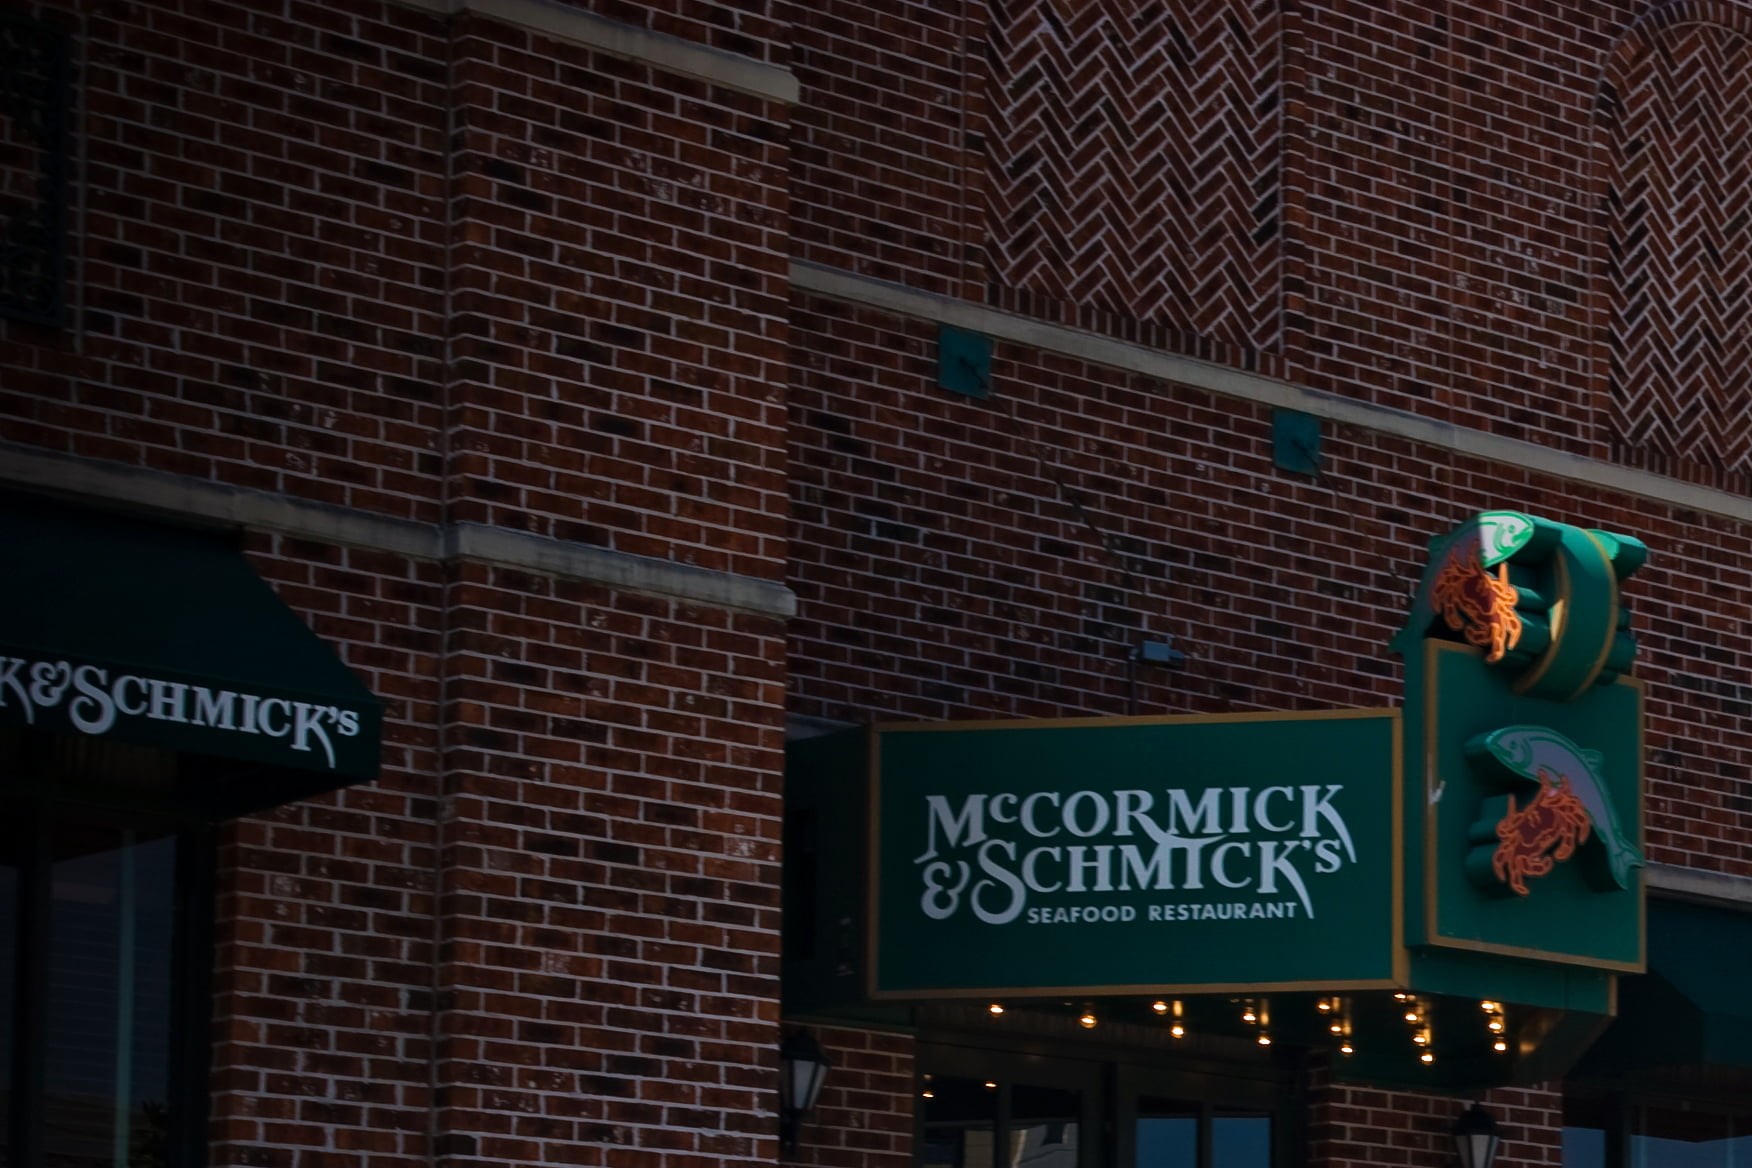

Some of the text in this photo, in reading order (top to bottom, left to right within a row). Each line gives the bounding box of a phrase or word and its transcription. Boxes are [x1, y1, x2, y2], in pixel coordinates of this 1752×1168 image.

[914, 785, 1357, 864] McCORMICK
[1027, 902, 1298, 924] SEAFOOD RESTAURANT
